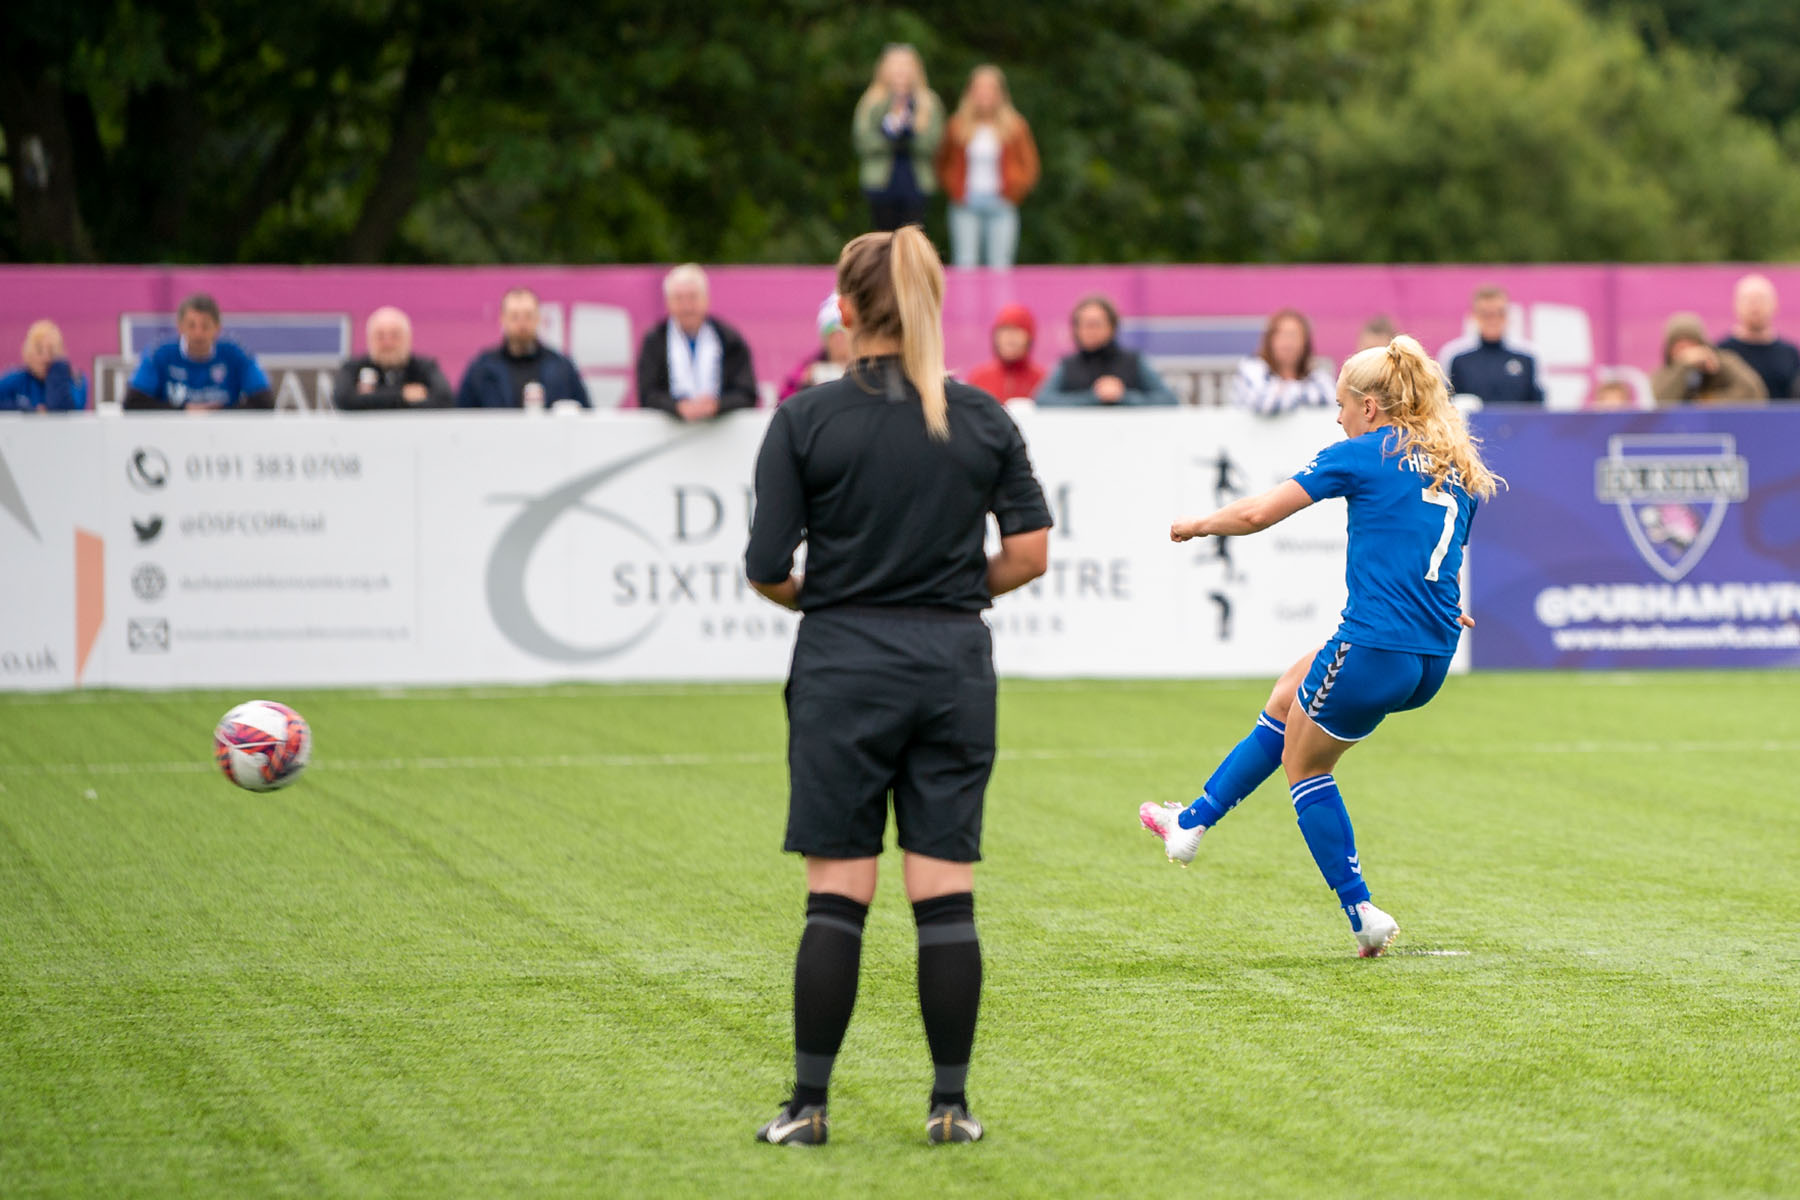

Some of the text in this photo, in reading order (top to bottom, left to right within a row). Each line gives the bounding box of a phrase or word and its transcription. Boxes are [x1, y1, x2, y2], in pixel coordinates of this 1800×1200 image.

[184, 453, 363, 482] 0191 383 0708
[1421, 487, 1459, 582] 7
